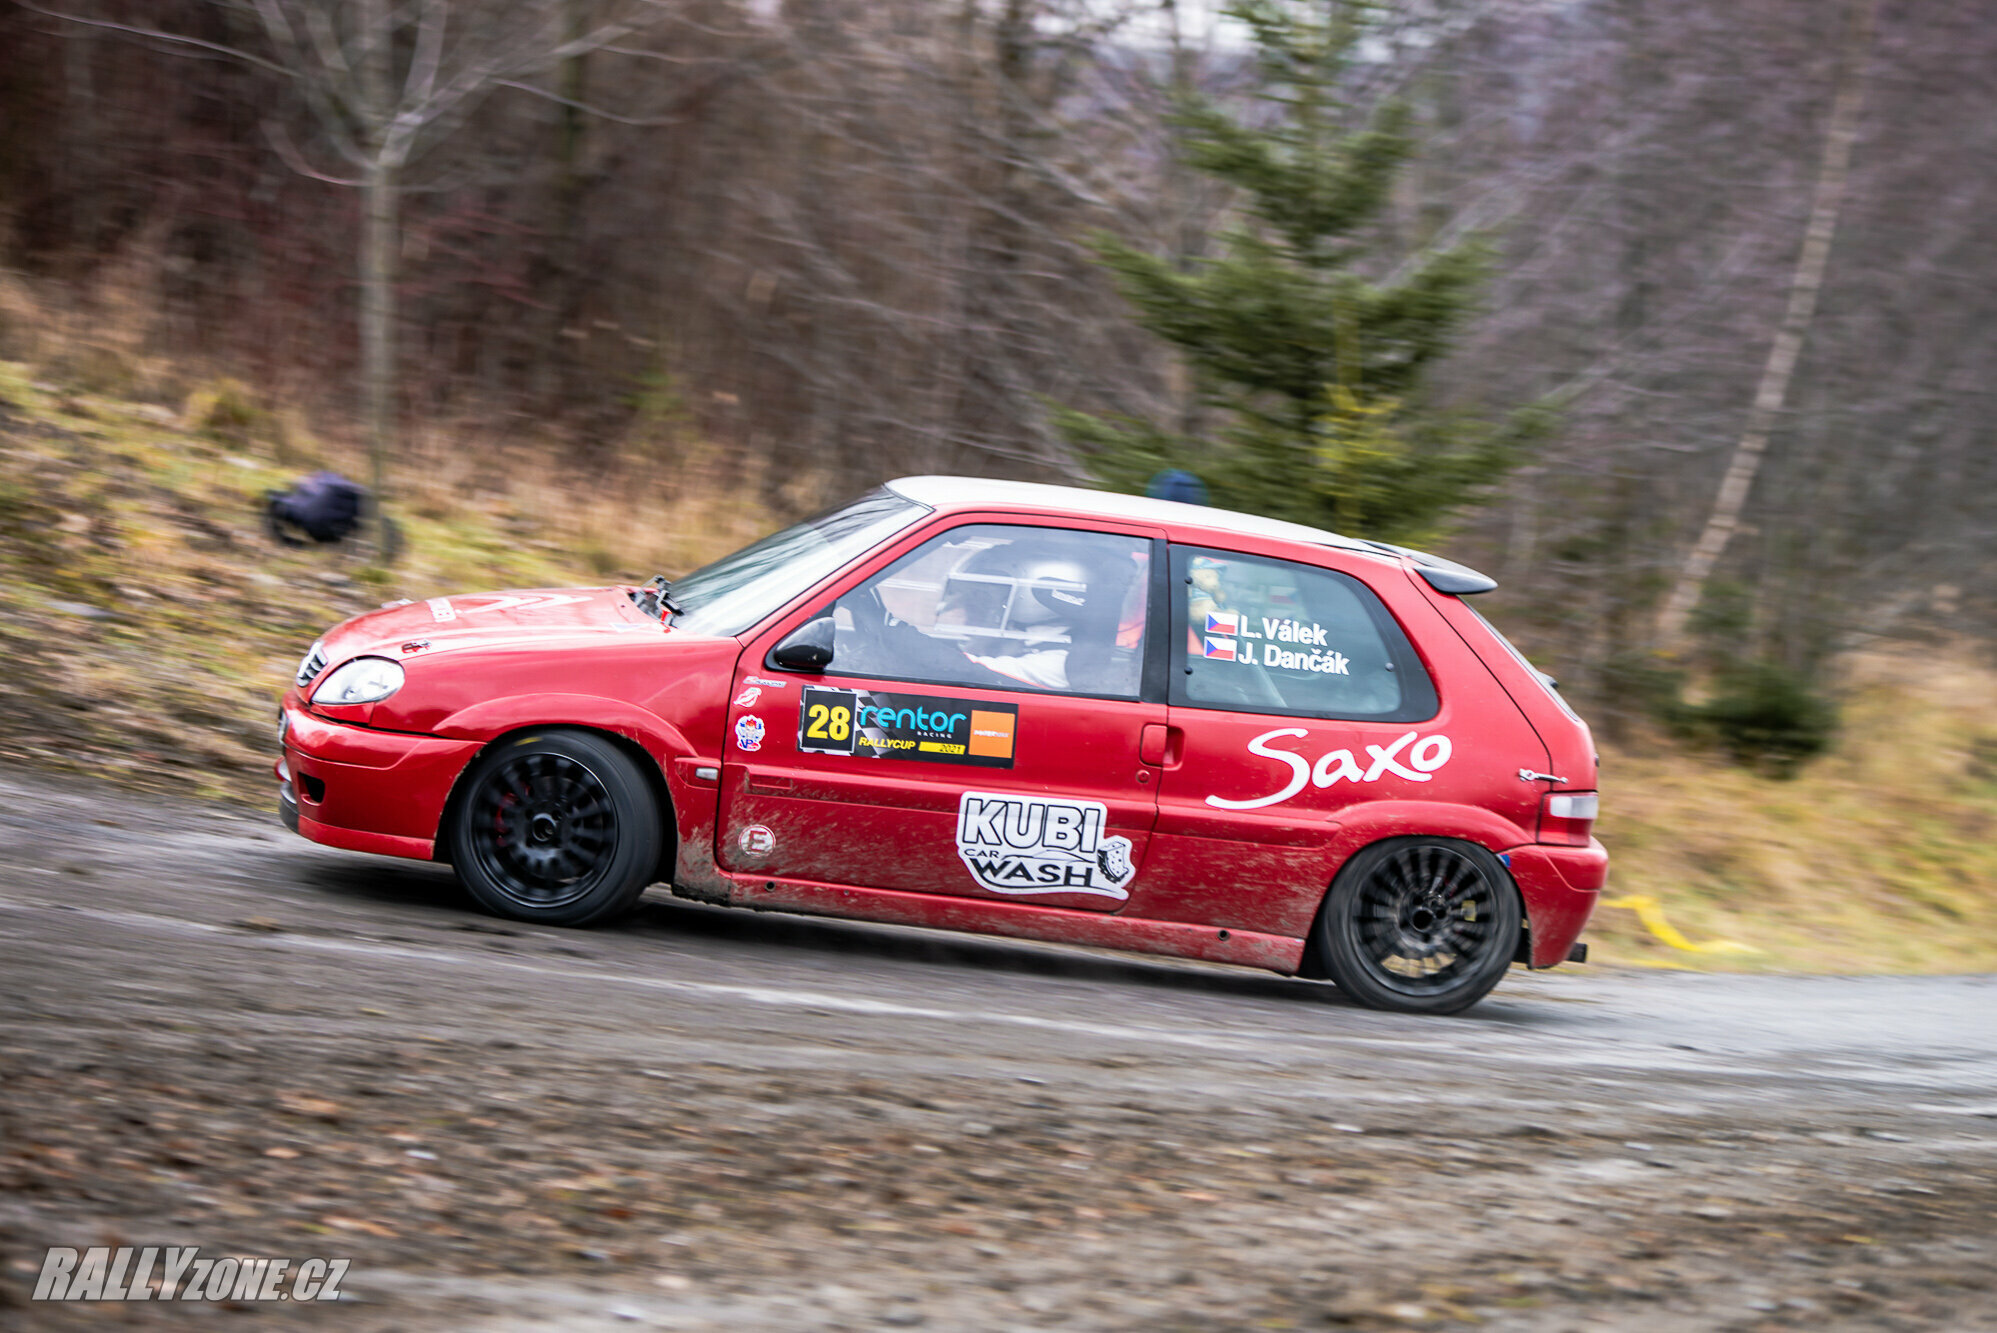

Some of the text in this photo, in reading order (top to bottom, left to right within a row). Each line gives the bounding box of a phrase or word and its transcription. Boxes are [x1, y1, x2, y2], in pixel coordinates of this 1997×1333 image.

[1237, 641, 1350, 676] J. Dančák
[806, 703, 851, 741] 28
[860, 705, 967, 734] rentor
[858, 736, 916, 750] RALLYCUP
[916, 731, 952, 739] RACING
[939, 744, 962, 754] 2021
[1205, 728, 1453, 810] Saxo
[962, 798, 1101, 854] KUBI
[963, 848, 1000, 859] CAR
[969, 857, 1093, 887] WASH
